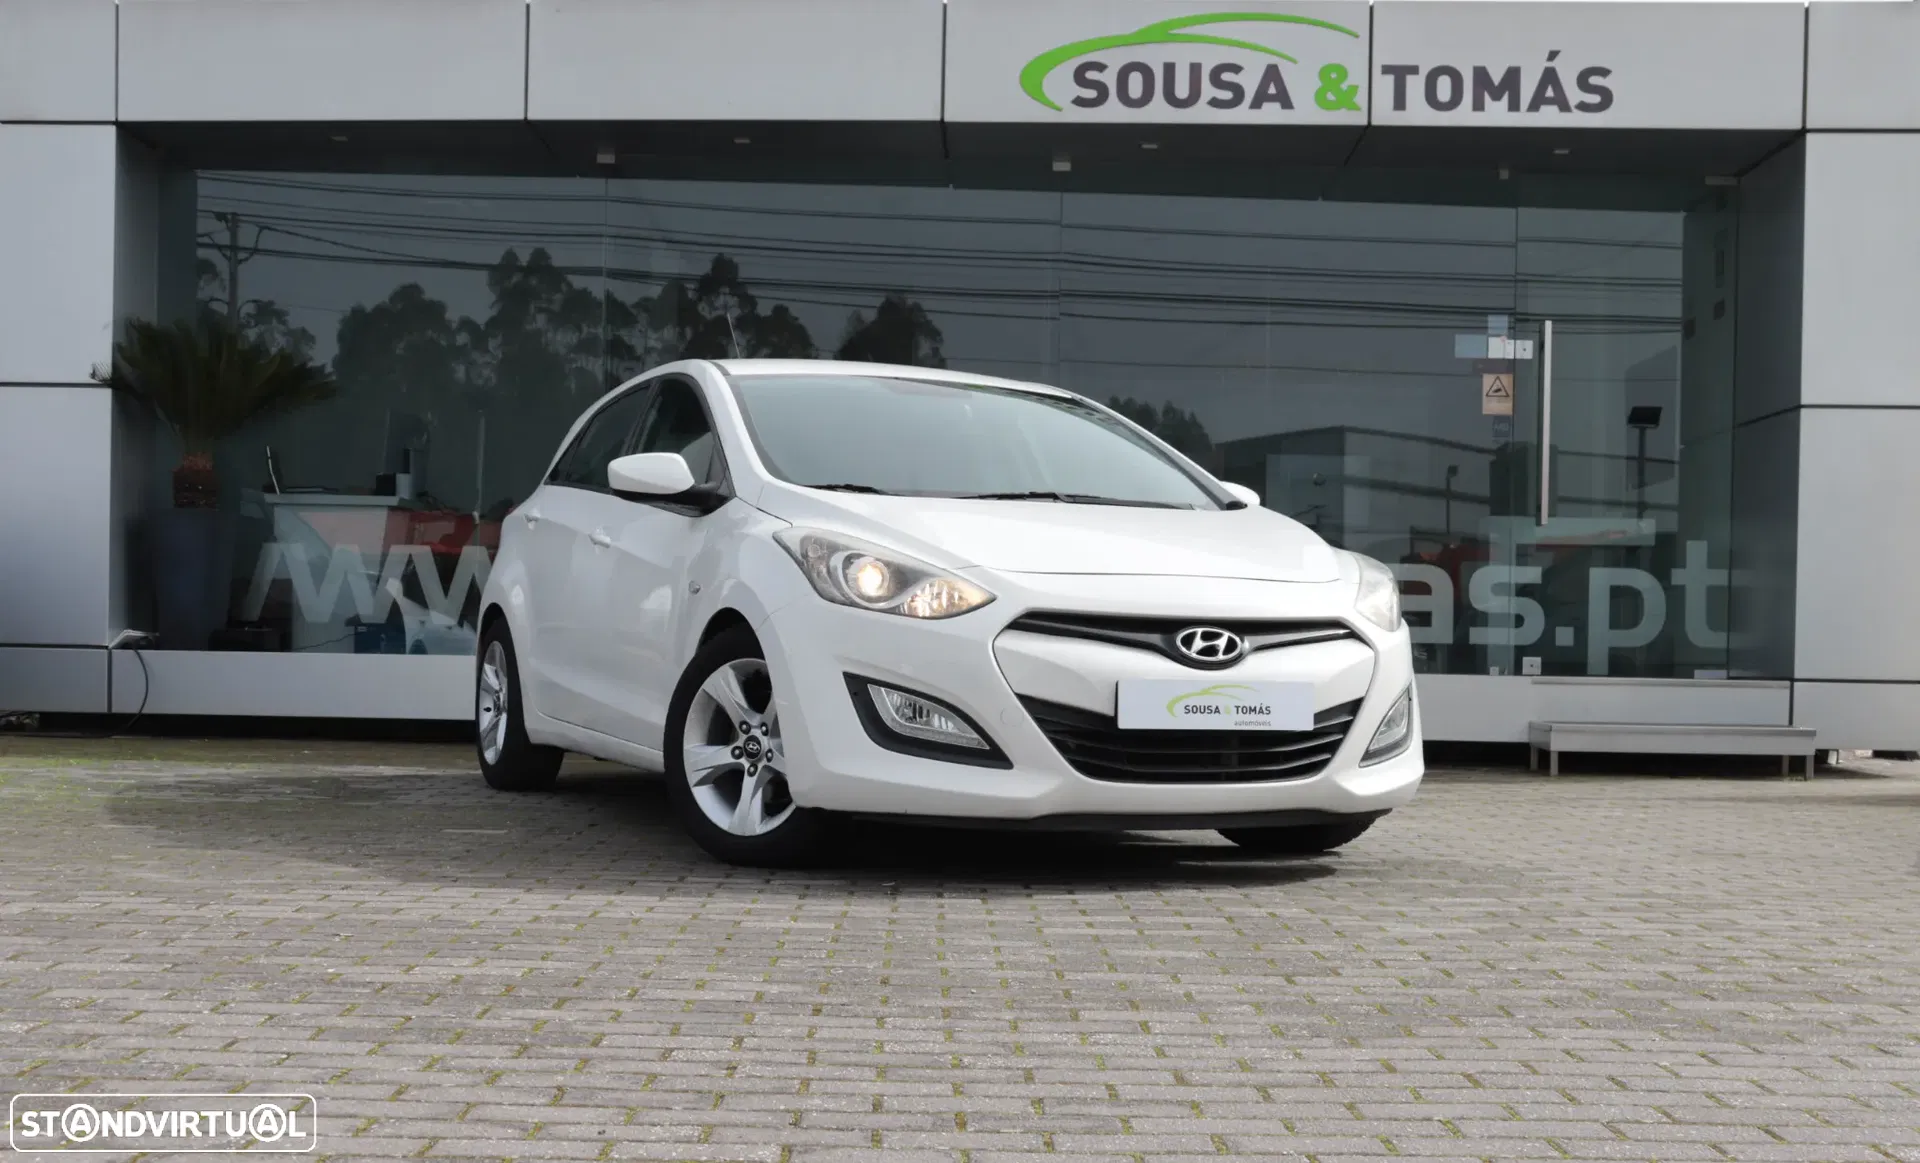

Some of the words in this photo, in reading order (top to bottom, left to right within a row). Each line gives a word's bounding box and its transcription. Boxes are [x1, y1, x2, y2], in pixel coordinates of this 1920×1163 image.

[1071, 61, 1295, 110] SOUSA
[1313, 62, 1362, 111] &
[1381, 50, 1614, 113] TOMÁS
[1184, 704, 1221, 715] SOUSA
[1234, 702, 1271, 715] TOMÁS
